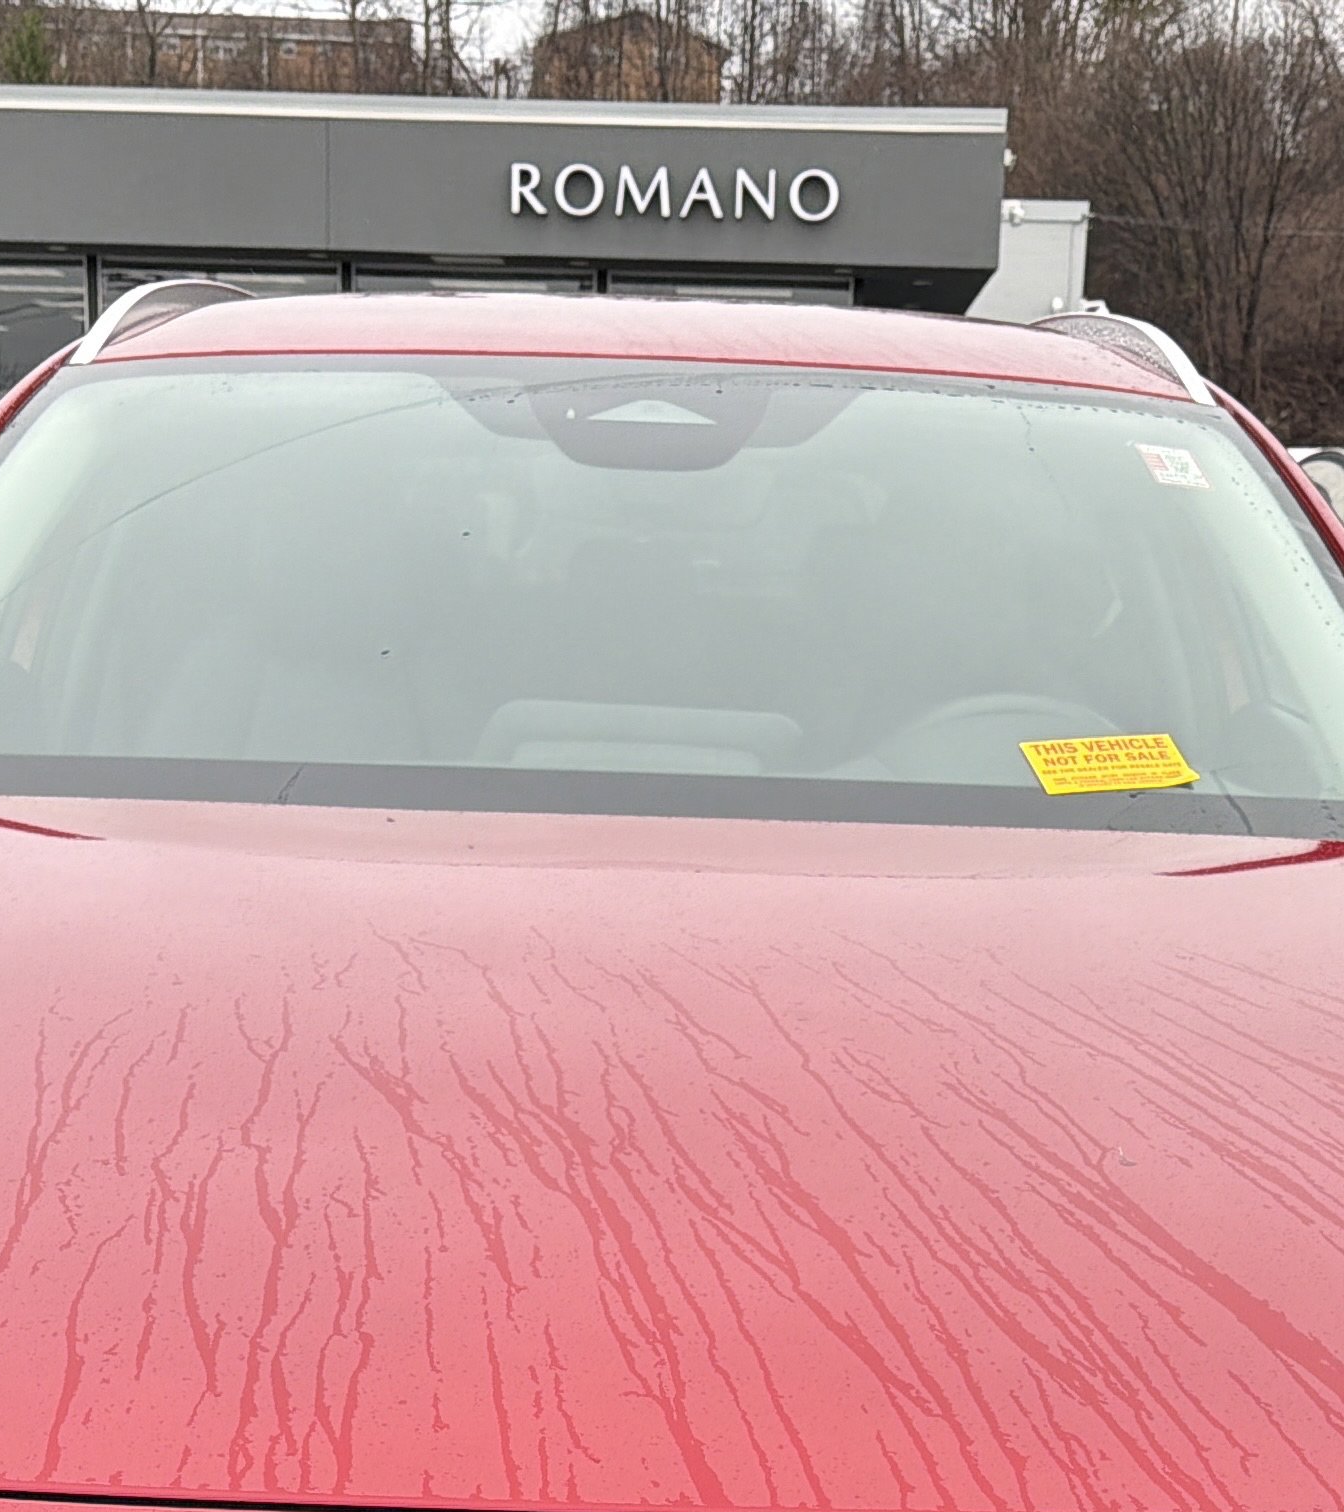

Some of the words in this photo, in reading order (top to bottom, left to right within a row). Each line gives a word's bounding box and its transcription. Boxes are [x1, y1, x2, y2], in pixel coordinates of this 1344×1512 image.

[510, 162, 841, 222] ROMANO
[1029, 742, 1078, 756] THIS
[1080, 737, 1169, 753] VEHICLE
[1042, 755, 1079, 767] NOT
[1083, 753, 1121, 764] FOR
[1125, 750, 1171, 762] SALE
